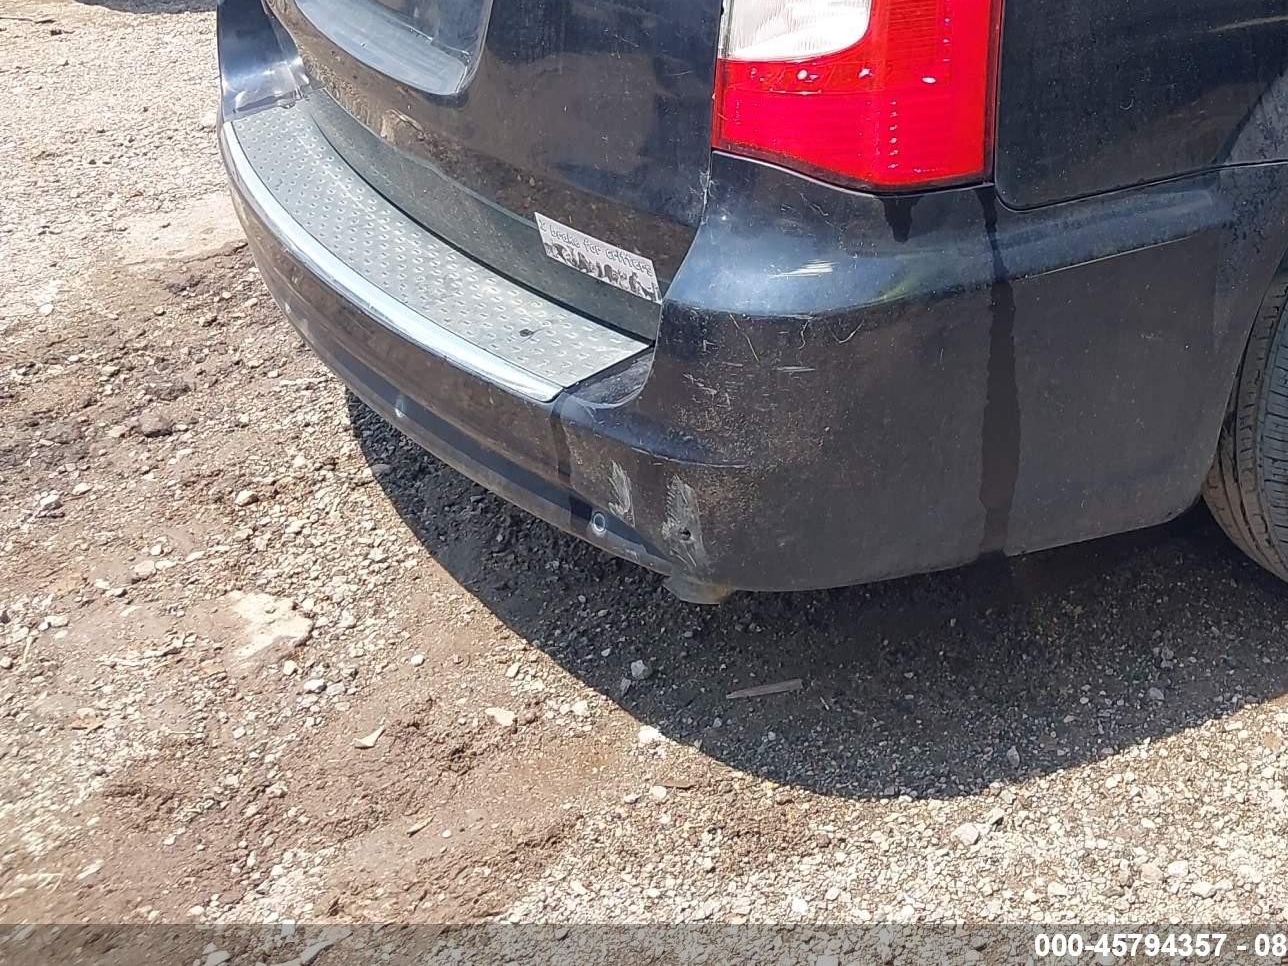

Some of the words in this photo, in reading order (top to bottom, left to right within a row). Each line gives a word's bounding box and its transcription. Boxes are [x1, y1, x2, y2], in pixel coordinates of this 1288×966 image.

[549, 225, 581, 248] brake
[583, 238, 602, 255] for
[605, 248, 654, 277] critters
